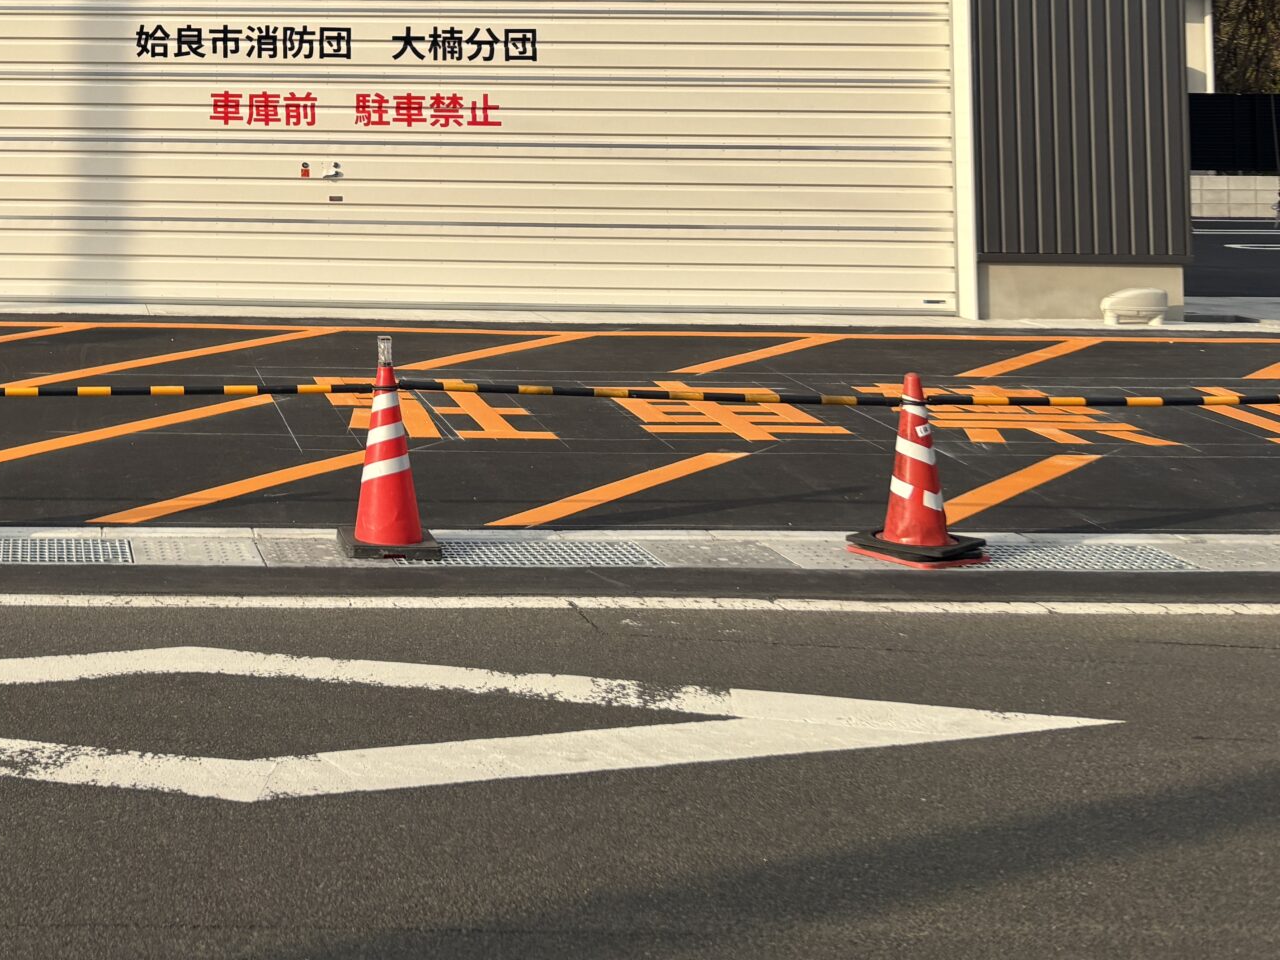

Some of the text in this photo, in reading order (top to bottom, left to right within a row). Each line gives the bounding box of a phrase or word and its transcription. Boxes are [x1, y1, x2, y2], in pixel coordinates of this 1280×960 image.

[136, 24, 538, 62] 姶良市消防団 大楠分団
[209, 91, 502, 128] 車庫前 駐車禁止
